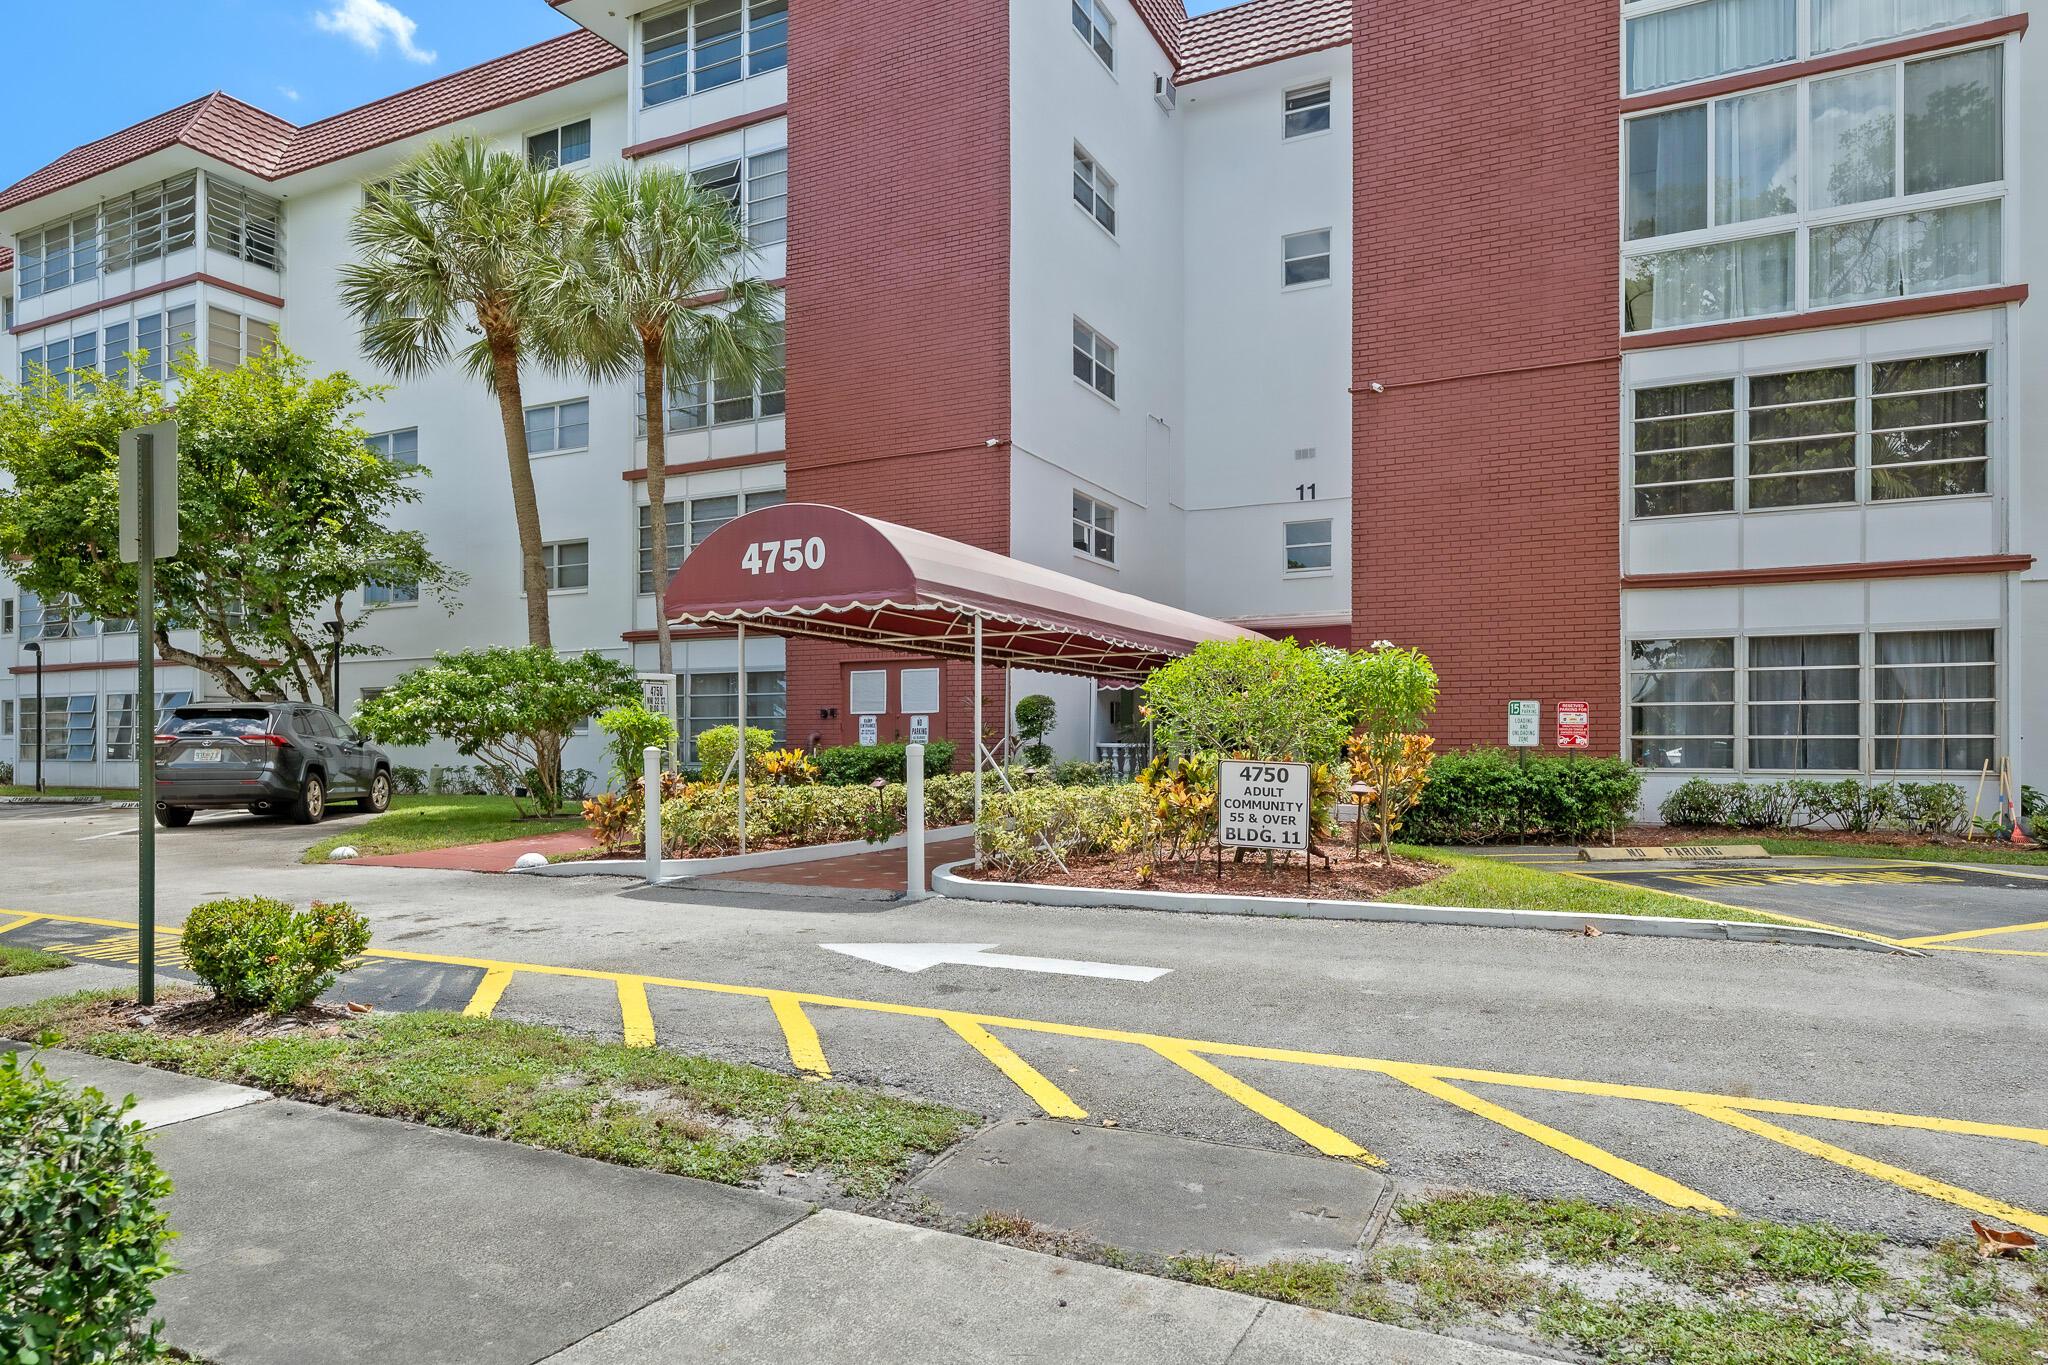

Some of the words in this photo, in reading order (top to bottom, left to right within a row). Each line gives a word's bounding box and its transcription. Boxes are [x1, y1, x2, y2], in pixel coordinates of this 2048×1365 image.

[1295, 483, 1316, 500] 11
[741, 536, 826, 575] 4750
[650, 686, 664, 696] 4750
[1510, 703, 1520, 714] 15
[912, 727, 927, 735] PARKING
[1239, 766, 1289, 783] 4750
[1243, 786, 1284, 798] ADULT
[1224, 799, 1303, 812] COMMUNITY
[1229, 813, 1244, 822] 55
[1249, 813, 1258, 823] &
[1263, 814, 1296, 825] OVER
[1225, 827, 1276, 843] BLDG.
[1282, 831, 1301, 844] 11
[1625, 848, 1646, 857] NO
[1663, 846, 1723, 857] PARKING
